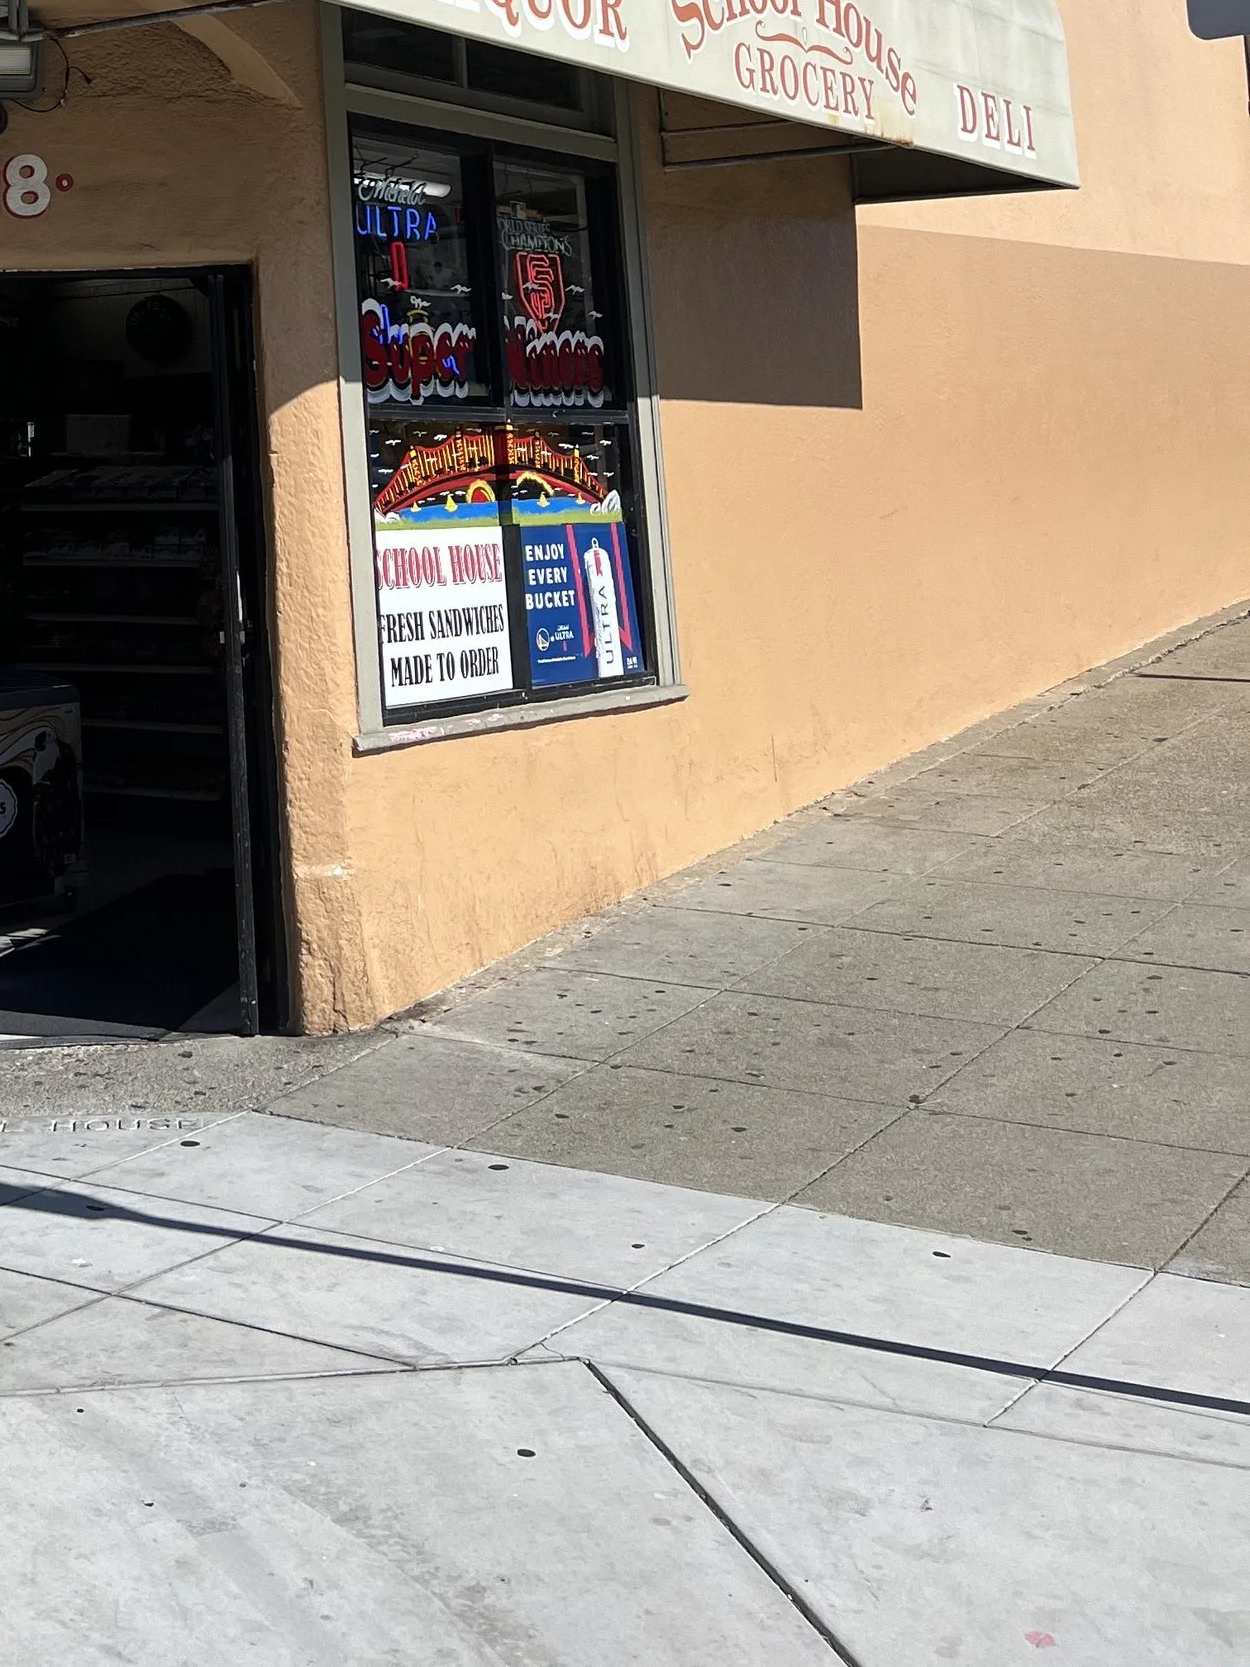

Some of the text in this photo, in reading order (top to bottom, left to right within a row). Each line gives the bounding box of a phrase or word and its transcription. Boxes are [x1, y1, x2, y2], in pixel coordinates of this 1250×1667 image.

[734, 41, 875, 121] GROCERY
[953, 83, 1037, 159] DELI
[355, 204, 439, 241] ULTRA
[361, 298, 476, 405] Super
[448, 543, 502, 585] HOUSE
[525, 543, 565, 562] ENJOY
[528, 566, 568, 585] EVERY
[525, 590, 575, 610] BUCKET
[377, 603, 505, 644] FRESH SANDWICHES
[554, 630, 575, 641] ULTRA
[598, 586, 615, 665] ULTRA
[390, 646, 500, 688] MADE TO ORDER
[49, 1117, 203, 1133] HOUSE
